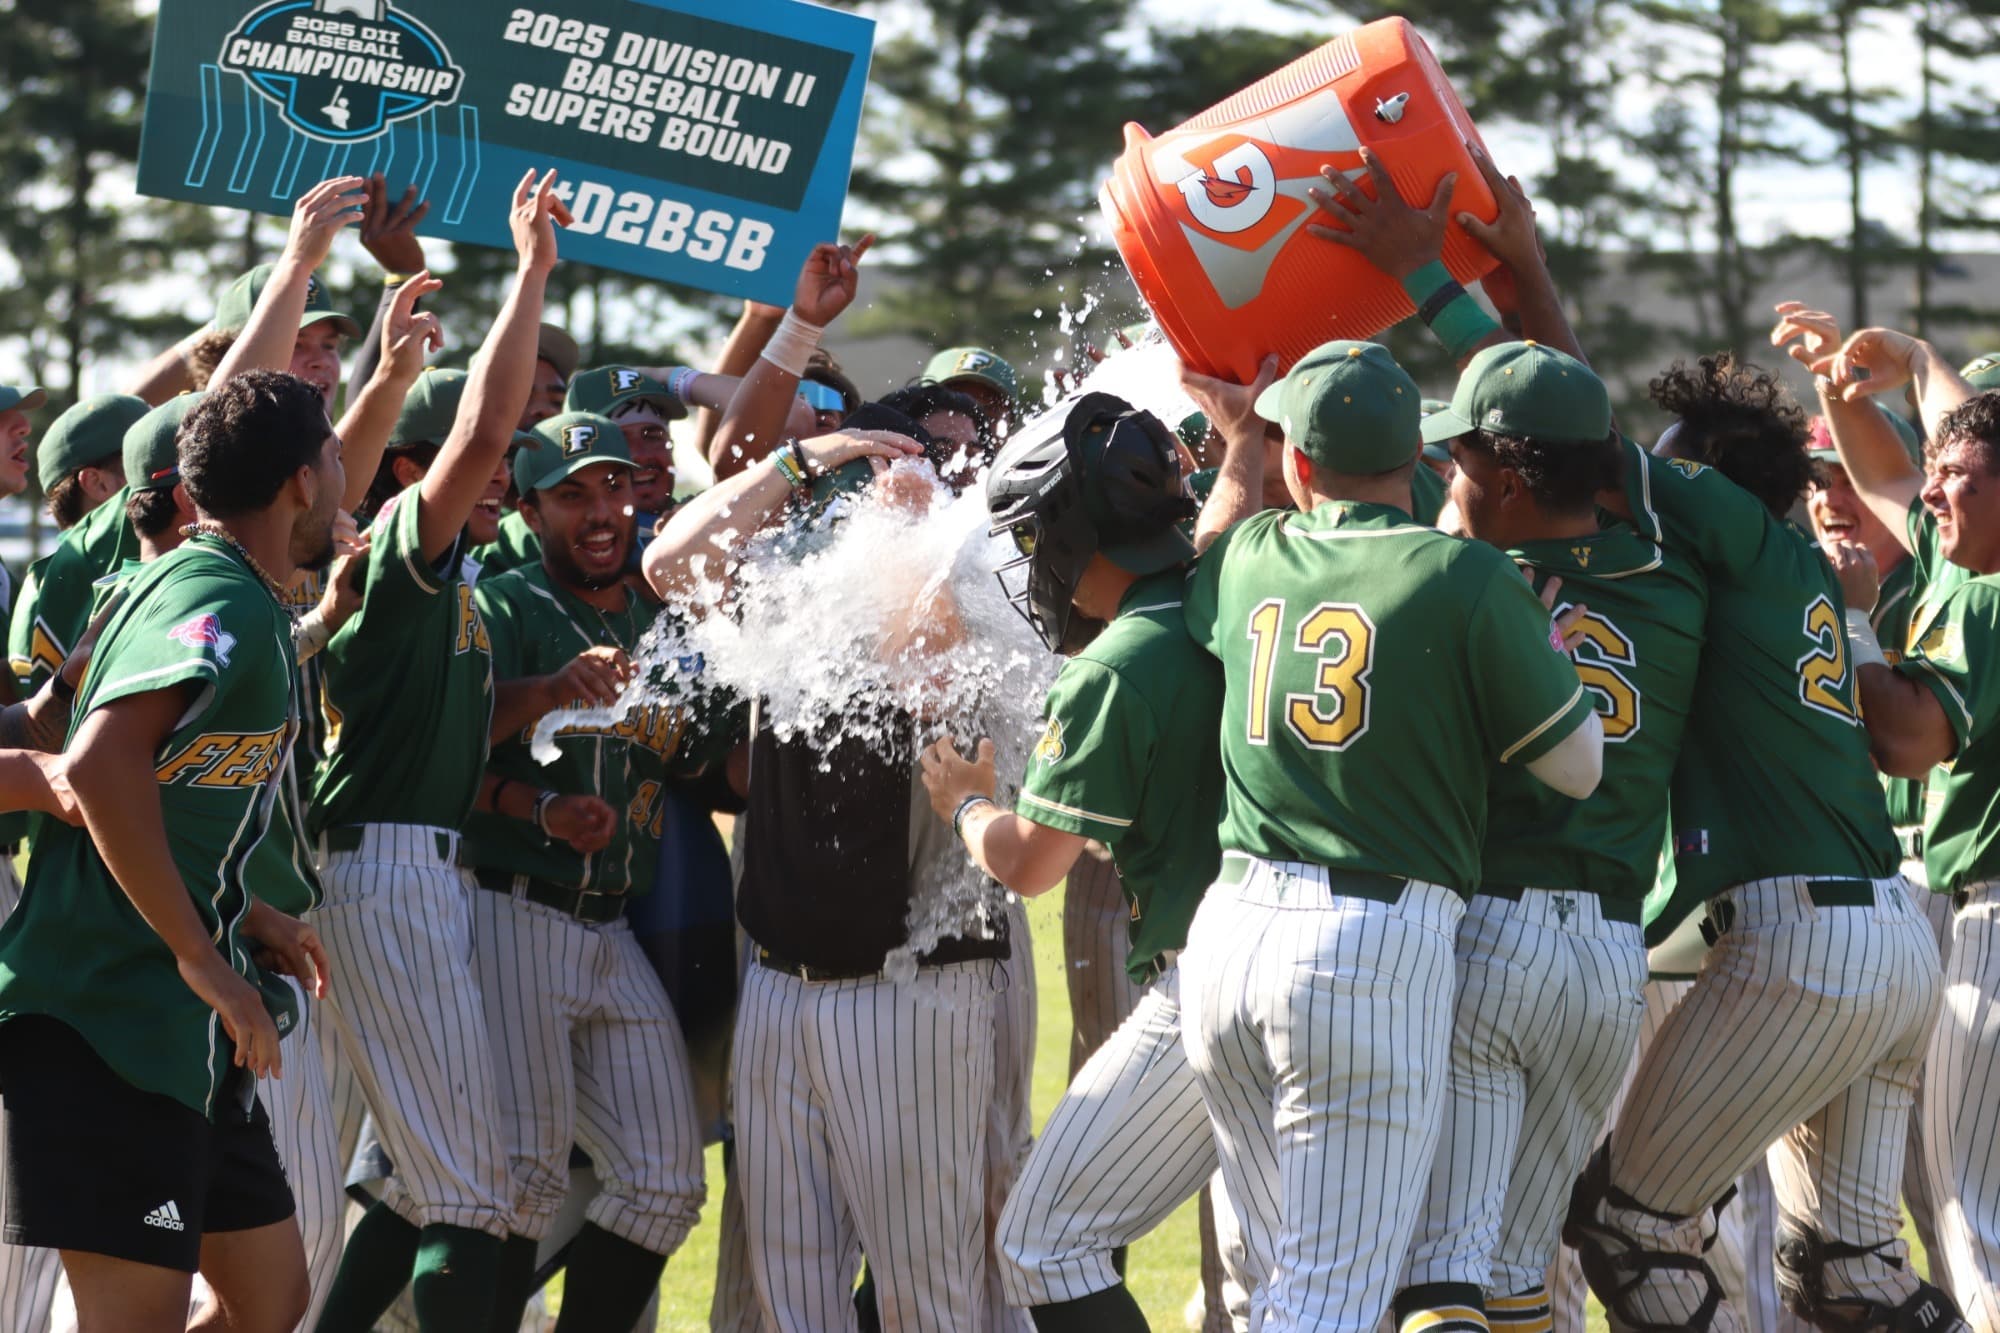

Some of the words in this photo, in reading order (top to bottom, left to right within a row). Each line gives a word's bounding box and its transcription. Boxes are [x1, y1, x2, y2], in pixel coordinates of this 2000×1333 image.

[286, 29, 403, 60] BASEBALL
[292, 16, 356, 37] 2025
[361, 27, 401, 45] DII
[503, 8, 611, 59] 2025
[612, 31, 782, 99] DIVISION
[783, 71, 817, 107] II
[228, 39, 455, 97] CHAMPIONSHIP
[561, 57, 741, 128] BASEBALL
[504, 82, 656, 143] SUPERS
[659, 116, 793, 175] BOUND
[1176, 141, 1276, 234] G
[612, 367, 641, 393] F
[957, 353, 991, 372] F
[563, 425, 595, 456] F
[1246, 597, 1376, 752] 13
[144, 1215, 184, 1231] adidas
